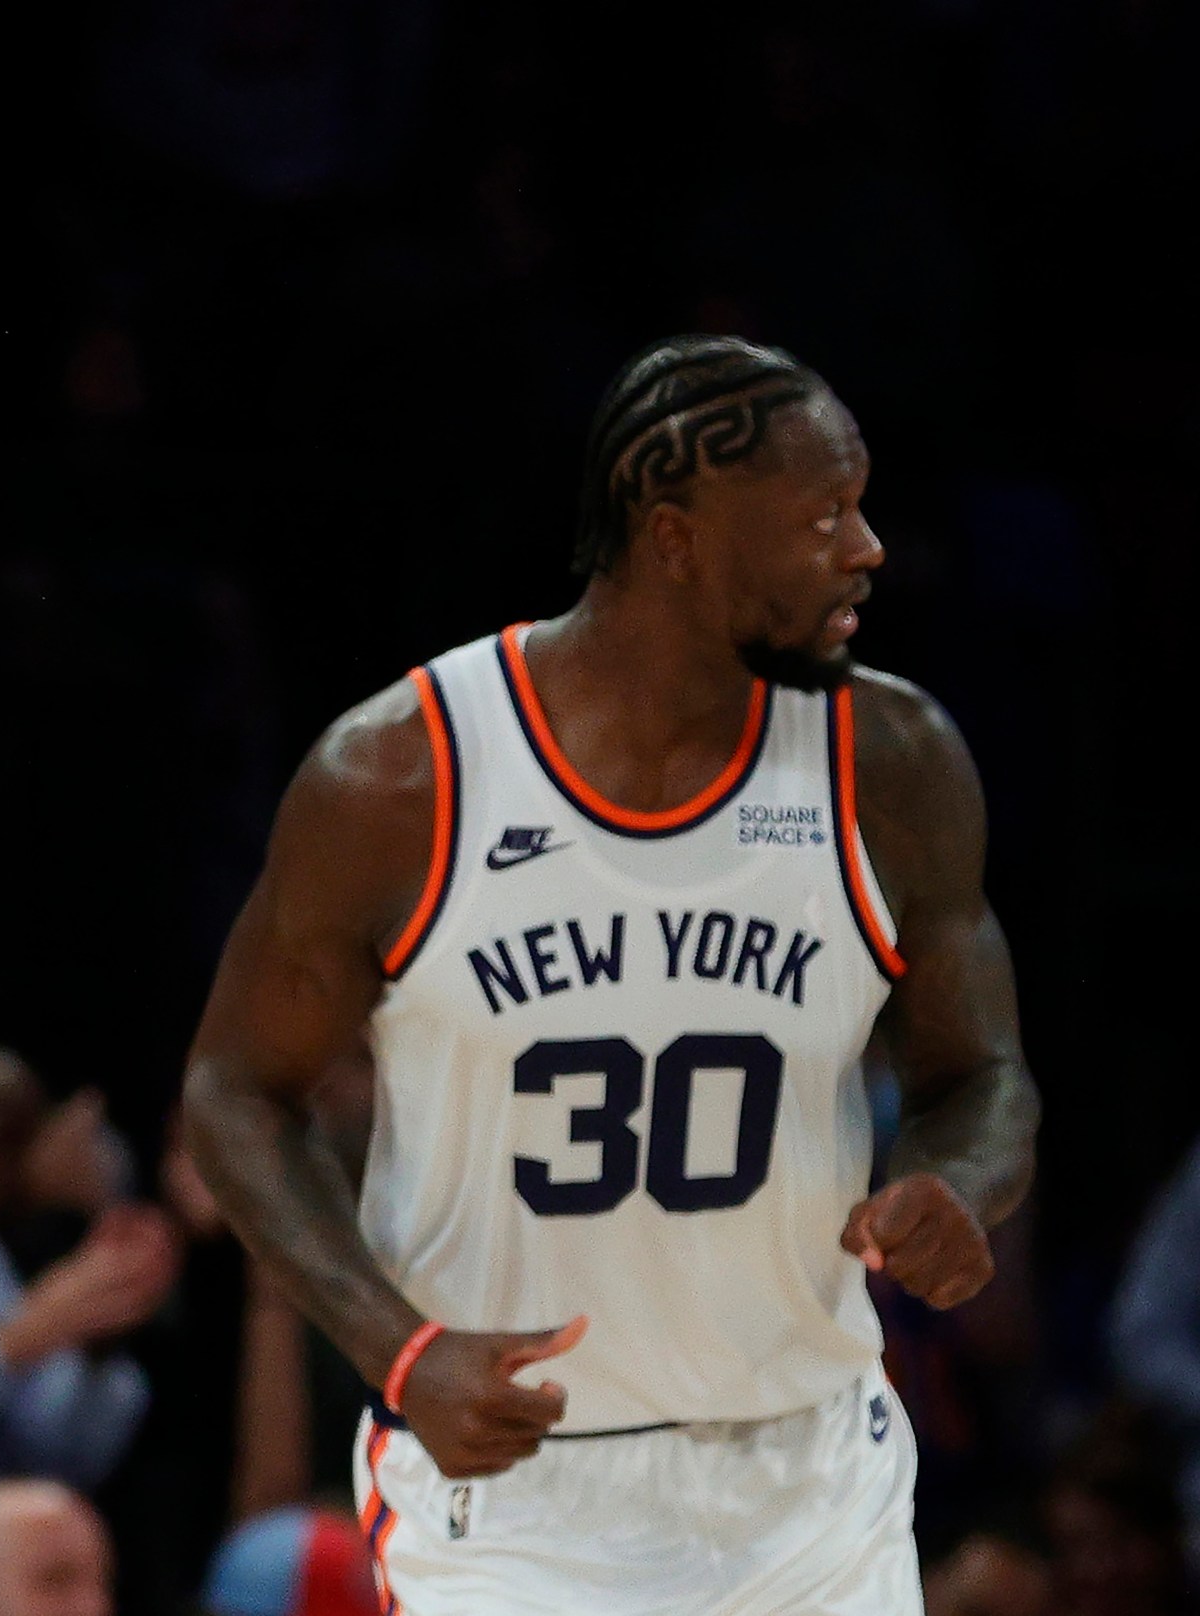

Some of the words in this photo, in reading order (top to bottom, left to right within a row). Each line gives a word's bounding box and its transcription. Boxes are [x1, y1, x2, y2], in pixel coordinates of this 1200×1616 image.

[739, 804, 822, 823] SQUARE
[739, 826, 806, 844] SPACE
[467, 912, 625, 1015] NEW
[658, 910, 824, 1007] YORK
[513, 1032, 784, 1216] 30
